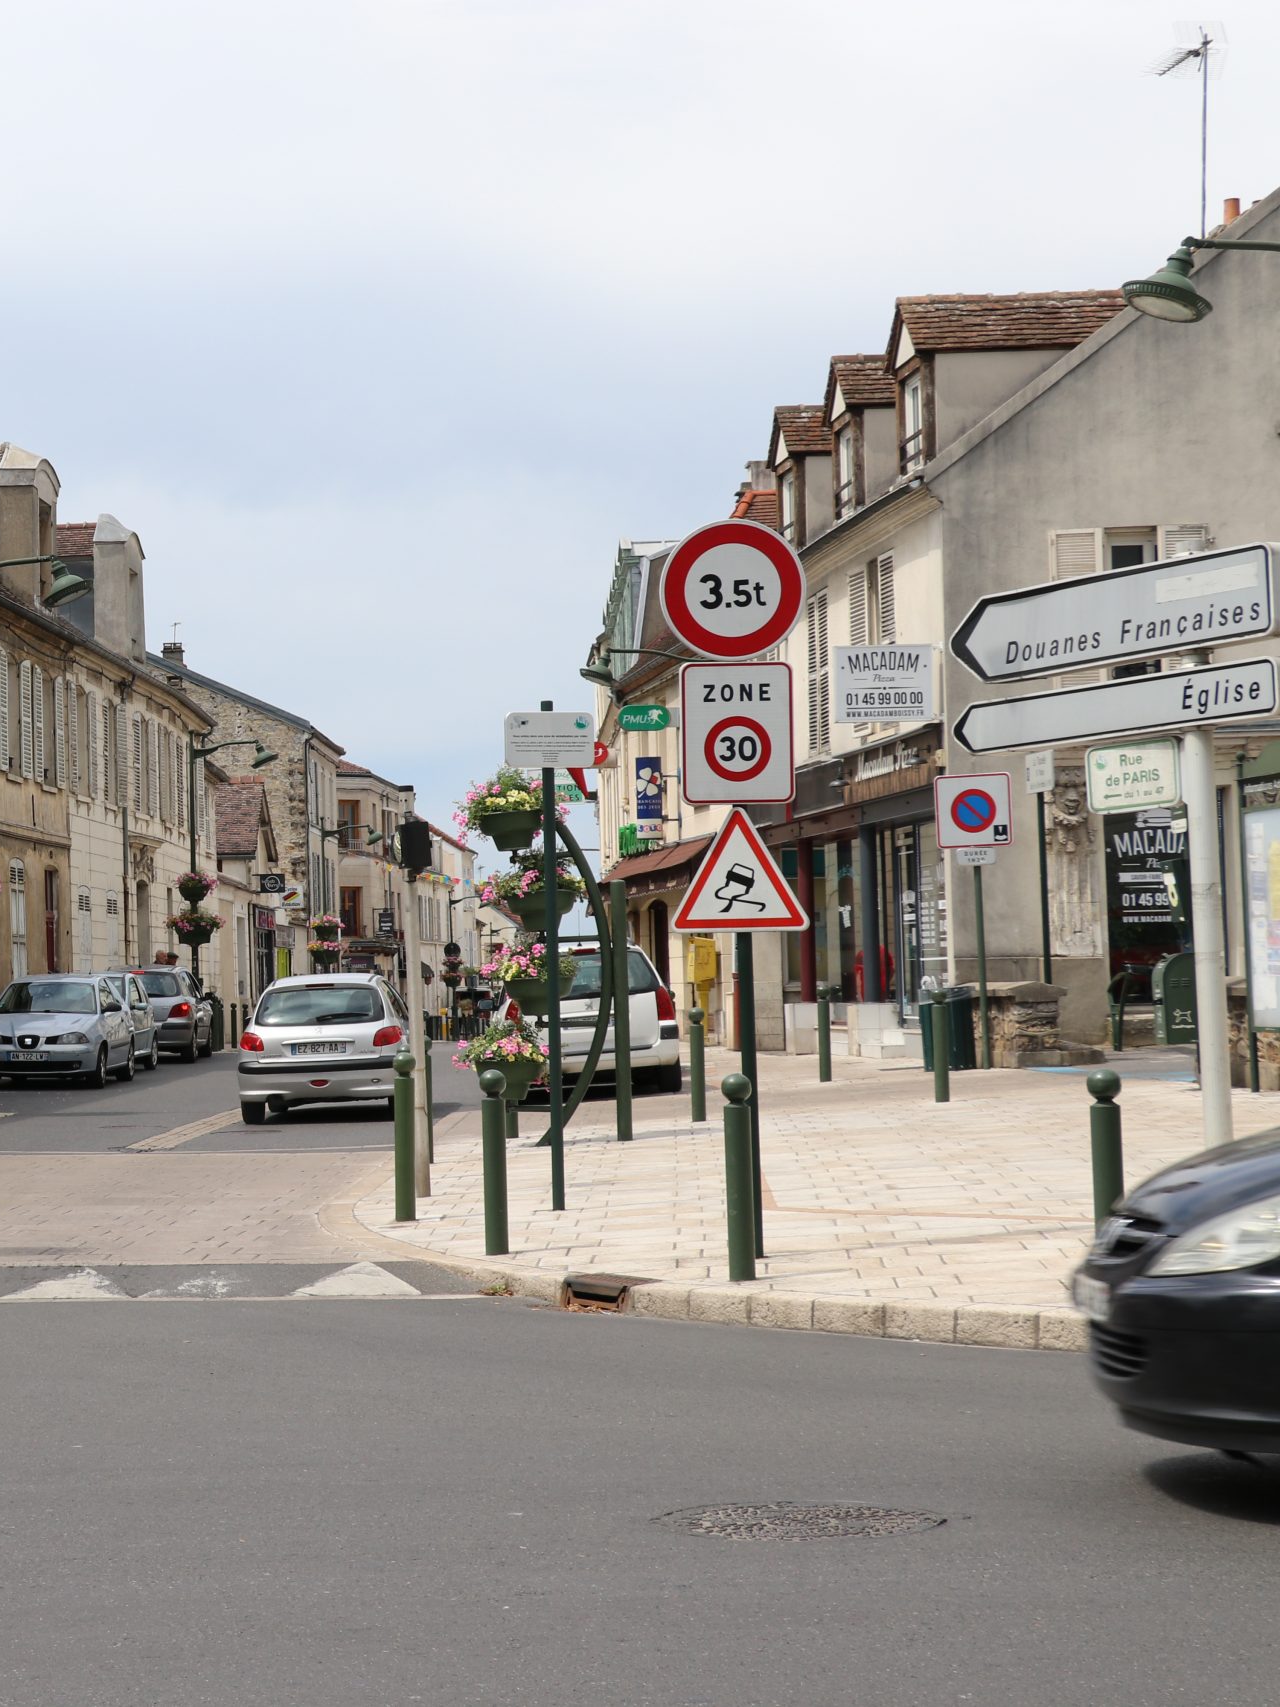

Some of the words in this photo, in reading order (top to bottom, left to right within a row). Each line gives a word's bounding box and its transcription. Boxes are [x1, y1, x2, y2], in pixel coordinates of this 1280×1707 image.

[699, 573, 767, 610] 3.5t
[1005, 630, 1101, 665] Douanes
[1120, 601, 1261, 644] Françaises
[847, 651, 920, 674] MACADAM
[873, 674, 895, 682] Pizza
[703, 683, 771, 702] ZONE
[846, 693, 859, 706] 01
[862, 693, 875, 705] 45
[878, 692, 891, 705] 99
[894, 692, 907, 705] 00
[910, 691, 923, 704] 00
[1181, 678, 1261, 714] Église
[623, 714, 648, 724] PMU
[846, 710, 924, 718] WWW.MACADAMBOISSY.FR
[719, 735, 757, 762] 30
[1120, 754, 1142, 767] Rue
[1106, 774, 1120, 786] de
[1123, 768, 1160, 785] PARIS
[1113, 829, 1185, 858] MACADA
[1122, 893, 1136, 906] 01
[1139, 893, 1153, 906] 45
[1122, 915, 1172, 923] WWW.MACADAM
